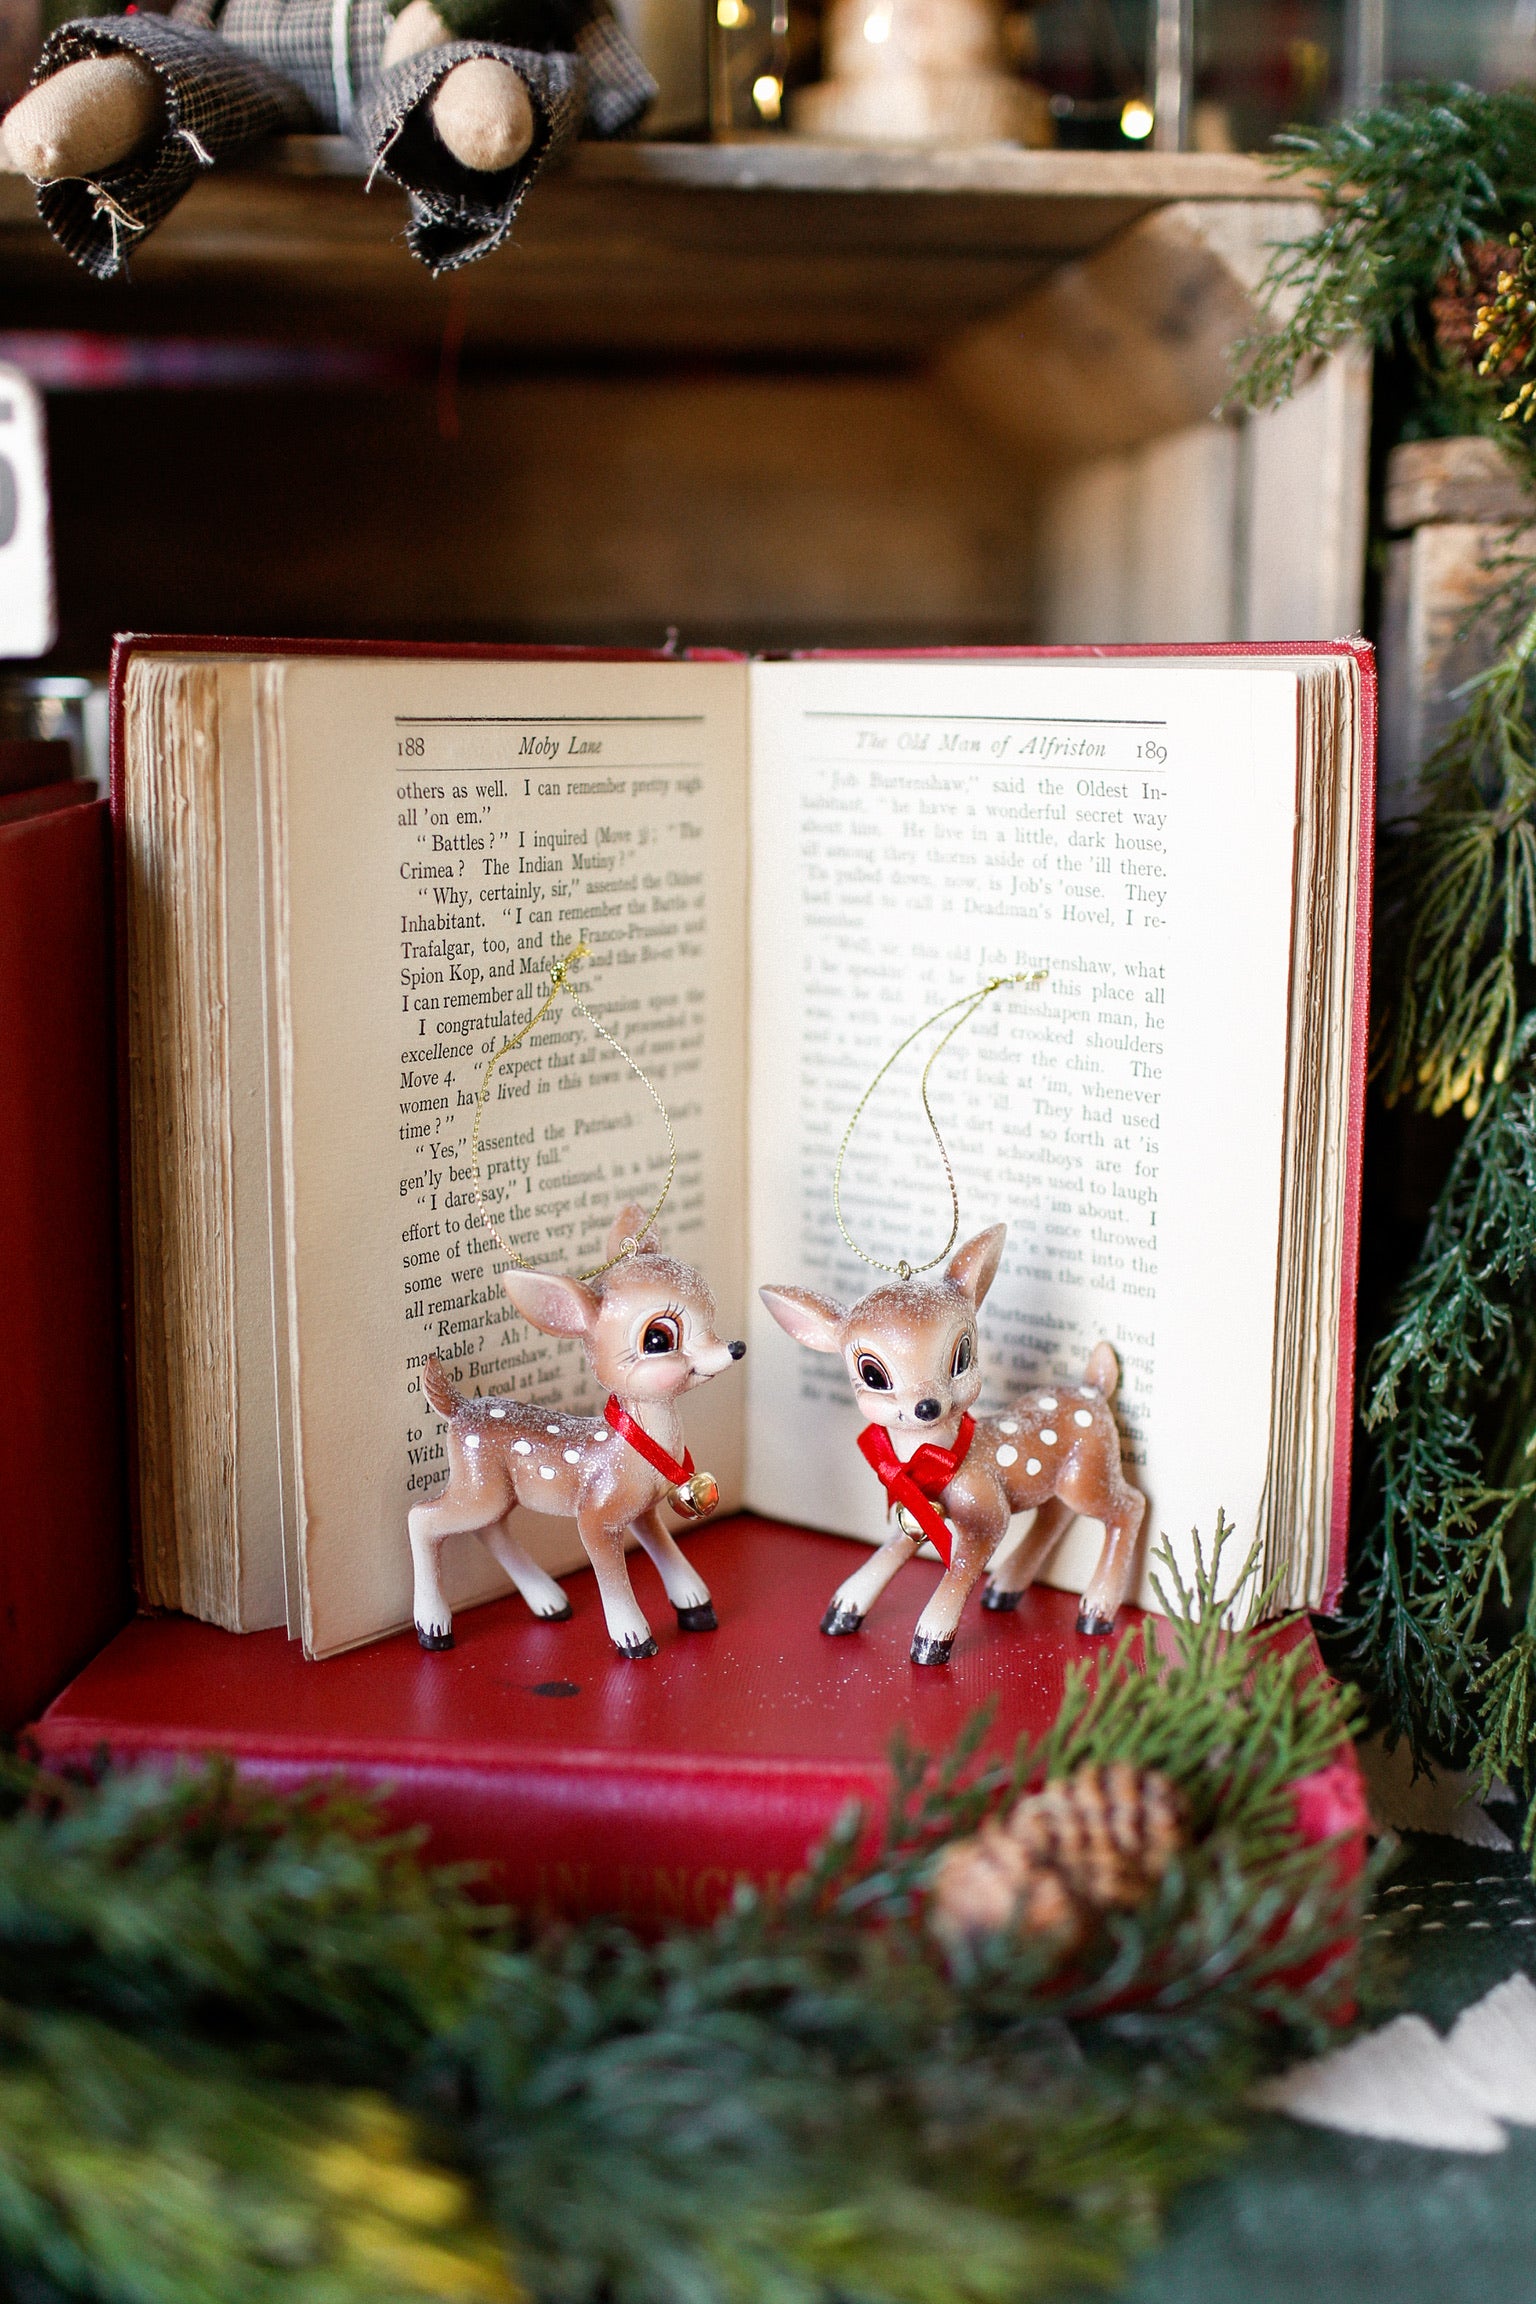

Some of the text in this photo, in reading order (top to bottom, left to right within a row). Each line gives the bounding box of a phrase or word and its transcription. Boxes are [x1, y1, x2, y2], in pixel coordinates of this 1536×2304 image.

[398, 737, 425, 756] 188
[518, 736, 559, 760] Moby
[938, 734, 980, 751] Man
[991, 735, 1012, 758] of
[1019, 736, 1105, 759] Alfriston
[1137, 741, 1167, 764] 189
[397, 782, 445, 799] others
[453, 786, 468, 798] as
[476, 780, 508, 797] well.
[524, 779, 530, 796] I
[538, 783, 560, 795] can
[567, 777, 625, 795] remember
[993, 778, 1167, 800] said the Oldest In-
[398, 809, 417, 826] all
[985, 804, 1167, 831] wonderful secret way
[519, 831, 525, 847] I
[534, 828, 587, 851] inquired
[996, 828, 1167, 854] a little, dark house,
[483, 858, 510, 876] The
[519, 856, 563, 873] Indian
[985, 852, 1025, 867] aside
[1033, 854, 1048, 869] of
[1057, 854, 1082, 871] the
[1120, 859, 1167, 877] there.
[480, 882, 544, 903] certainly,
[586, 874, 637, 894] assented
[1010, 876, 1052, 895] Job’s
[1125, 884, 1167, 907] They
[401, 913, 485, 933] Inhabitant.
[529, 911, 552, 923] can
[559, 901, 621, 921] remember
[1063, 904, 1115, 927] Hovel,
[1126, 909, 1133, 925] I
[1144, 915, 1166, 928] re-
[401, 930, 571, 960] Trafalgar, too, and the
[401, 967, 443, 990] Spion
[450, 963, 484, 985] Kop,
[489, 958, 515, 978] and
[978, 946, 1007, 966] Job
[1016, 950, 1116, 977] Burtenshaw,
[1125, 961, 1165, 979] what
[403, 983, 532, 1012] I can remember all
[1052, 979, 1165, 1004] this place all
[419, 1008, 563, 1036] I congratulated my
[1008, 1000, 1165, 1029] misshapen man, he
[401, 1043, 473, 1063] excellence
[482, 1037, 495, 1053] of
[1011, 1026, 1163, 1055] crooked shoulders
[400, 1072, 438, 1089] Move
[444, 1071, 455, 1087] 4.
[499, 1059, 542, 1077] expect
[548, 1052, 574, 1068] that
[1032, 1051, 1057, 1068] the
[1066, 1054, 1104, 1073] chin.
[1130, 1061, 1162, 1079] The
[400, 1073, 581, 1114] women have lived in this
[1018, 1076, 1161, 1104] at whenever
[1033, 1098, 1160, 1129] They had used
[477, 1127, 534, 1152] assented
[544, 1124, 565, 1140] the
[1003, 1122, 1130, 1150] and so forth at
[998, 1144, 1159, 1178] schoolboys are for
[400, 1156, 530, 1196] gen’ly pratty
[445, 1192, 475, 1208] dare
[526, 1177, 531, 1192] I
[1049, 1176, 1157, 1206] used to laugh
[402, 1204, 531, 1242] effort to the
[1078, 1202, 1156, 1226] about. I
[403, 1223, 574, 1268] some of them were very
[1091, 1227, 1157, 1250] throwed
[1093, 1251, 1124, 1268] into
[1133, 1257, 1158, 1274] the
[404, 1267, 483, 1294] some were
[1059, 1269, 1156, 1299] the old men
[405, 1301, 424, 1319] all
[1117, 1325, 1155, 1346] lived
[520, 1373, 532, 1388] at
[1135, 1376, 1153, 1391] he
[407, 1428, 422, 1442] to
[408, 1443, 444, 1466] With
